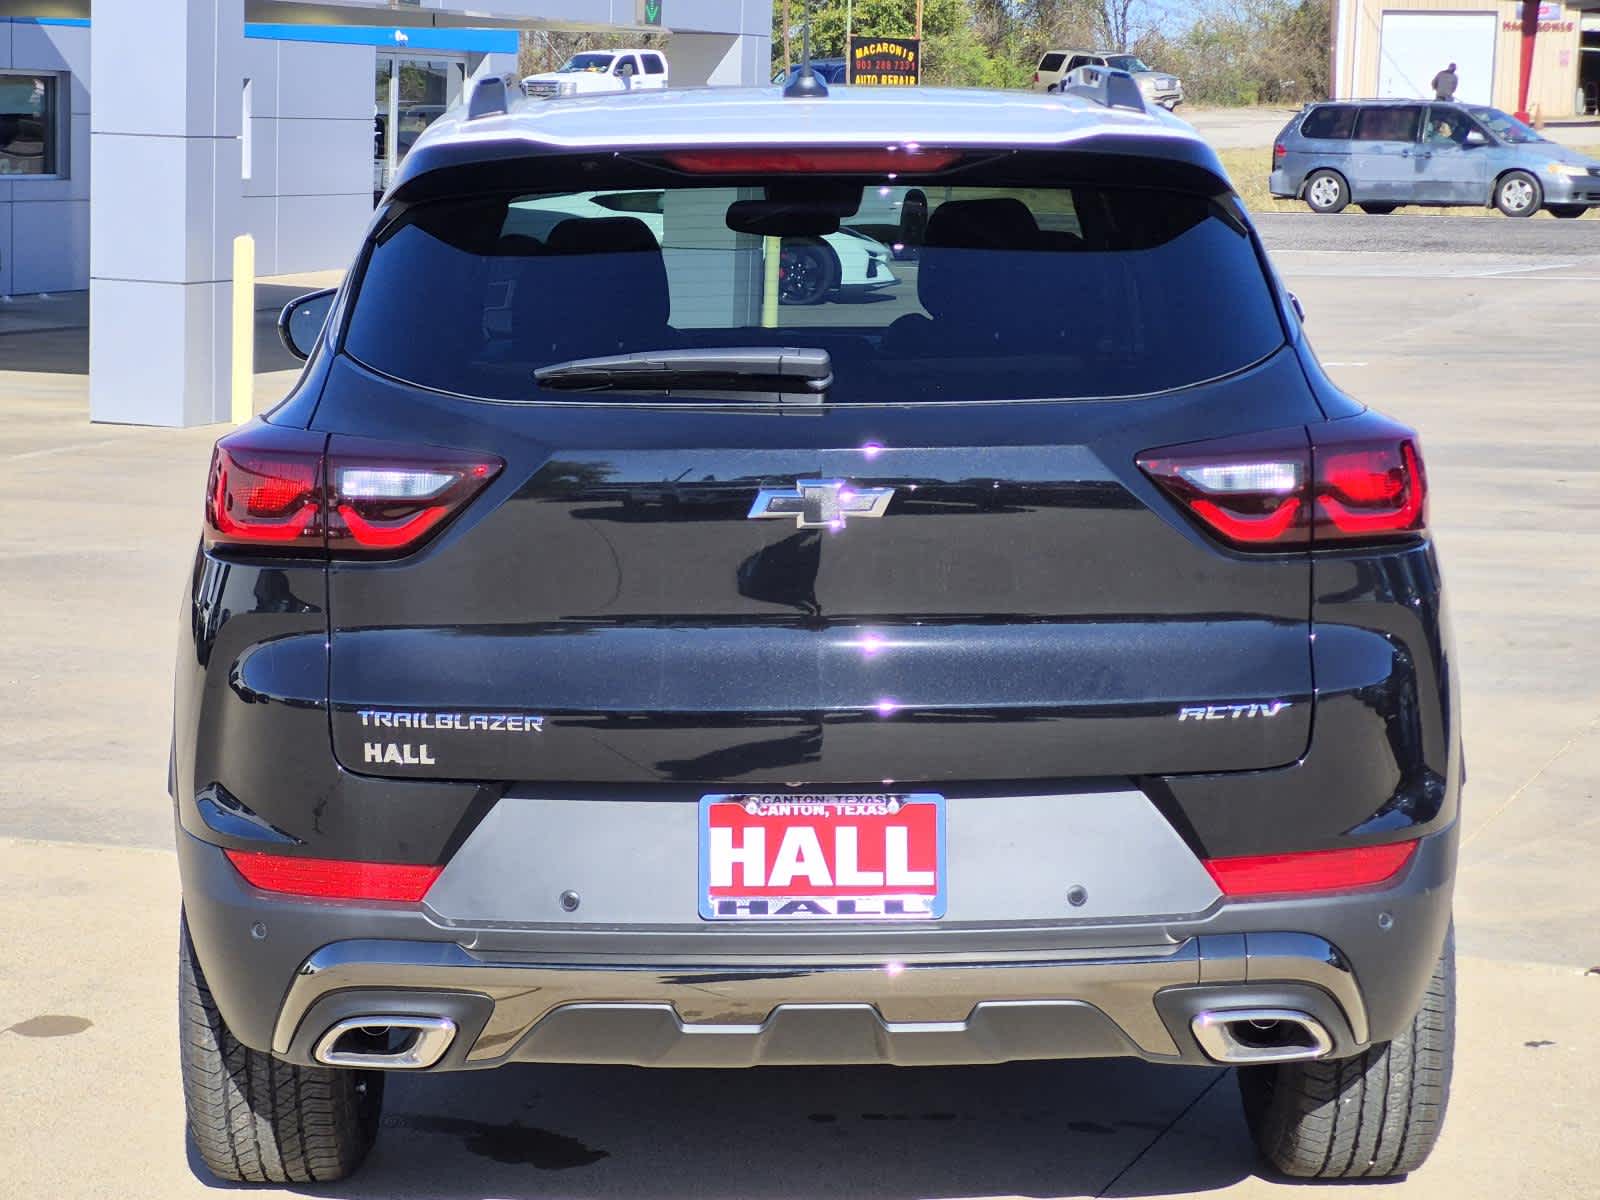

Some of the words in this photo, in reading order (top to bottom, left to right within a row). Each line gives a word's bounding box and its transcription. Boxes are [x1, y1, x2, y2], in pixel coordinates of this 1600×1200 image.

[855, 74, 878, 85] AUTO
[881, 74, 916, 86] REPAIR
[357, 710, 545, 732] TRAILBLAZER
[1179, 702, 1293, 721] ACTIV
[364, 742, 435, 765] HALL
[836, 804, 889, 816] TEXAS
[710, 826, 935, 887] HALL
[717, 900, 931, 915] HALL
